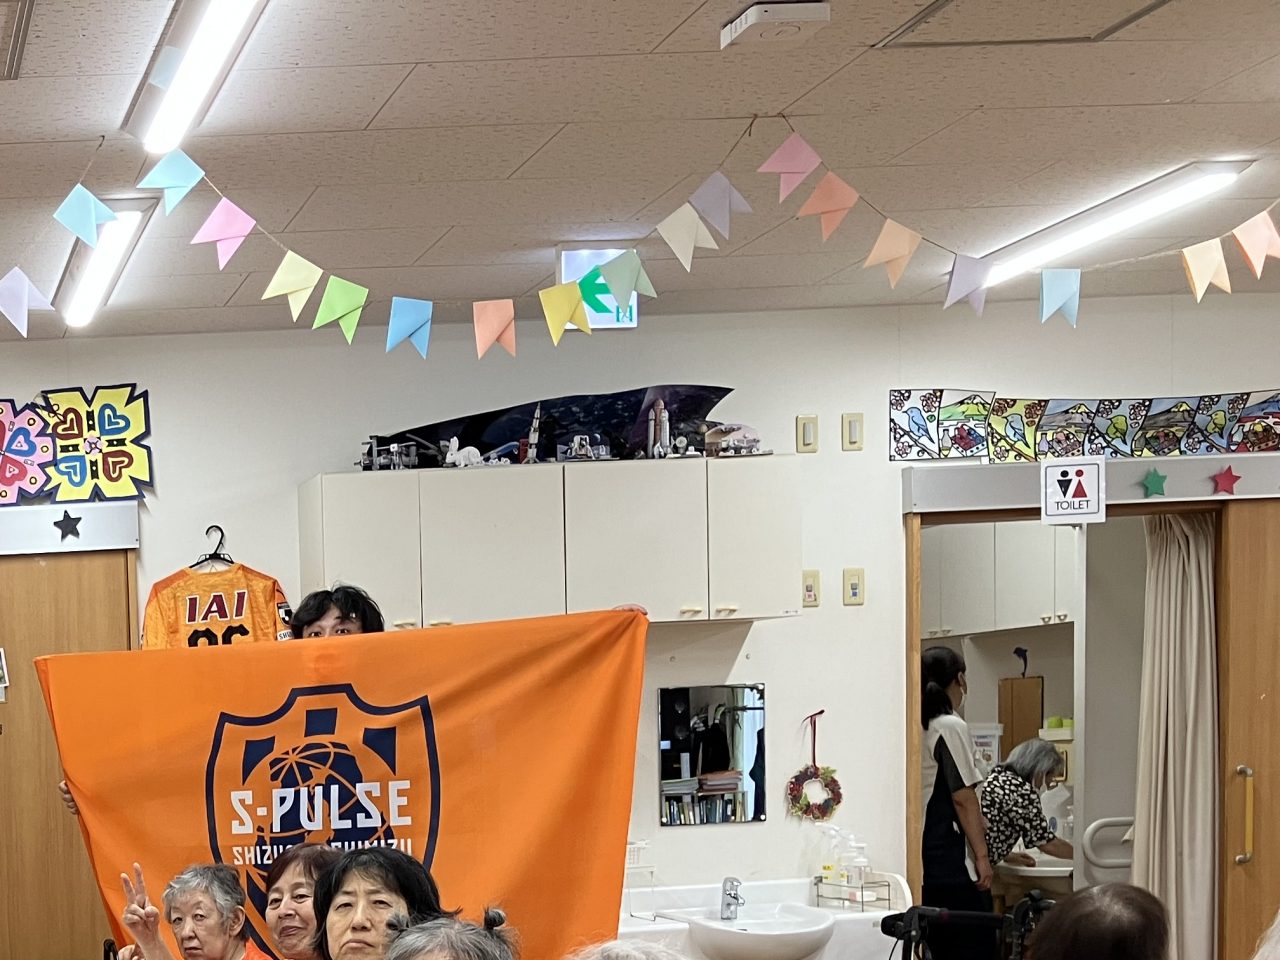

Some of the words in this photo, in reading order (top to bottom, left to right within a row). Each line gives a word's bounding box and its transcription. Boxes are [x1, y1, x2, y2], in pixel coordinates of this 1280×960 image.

[1054, 500, 1091, 511] TOILET
[186, 590, 247, 624] IAI
[231, 780, 412, 834] S-PULSE
[232, 844, 294, 866] SHIZU
